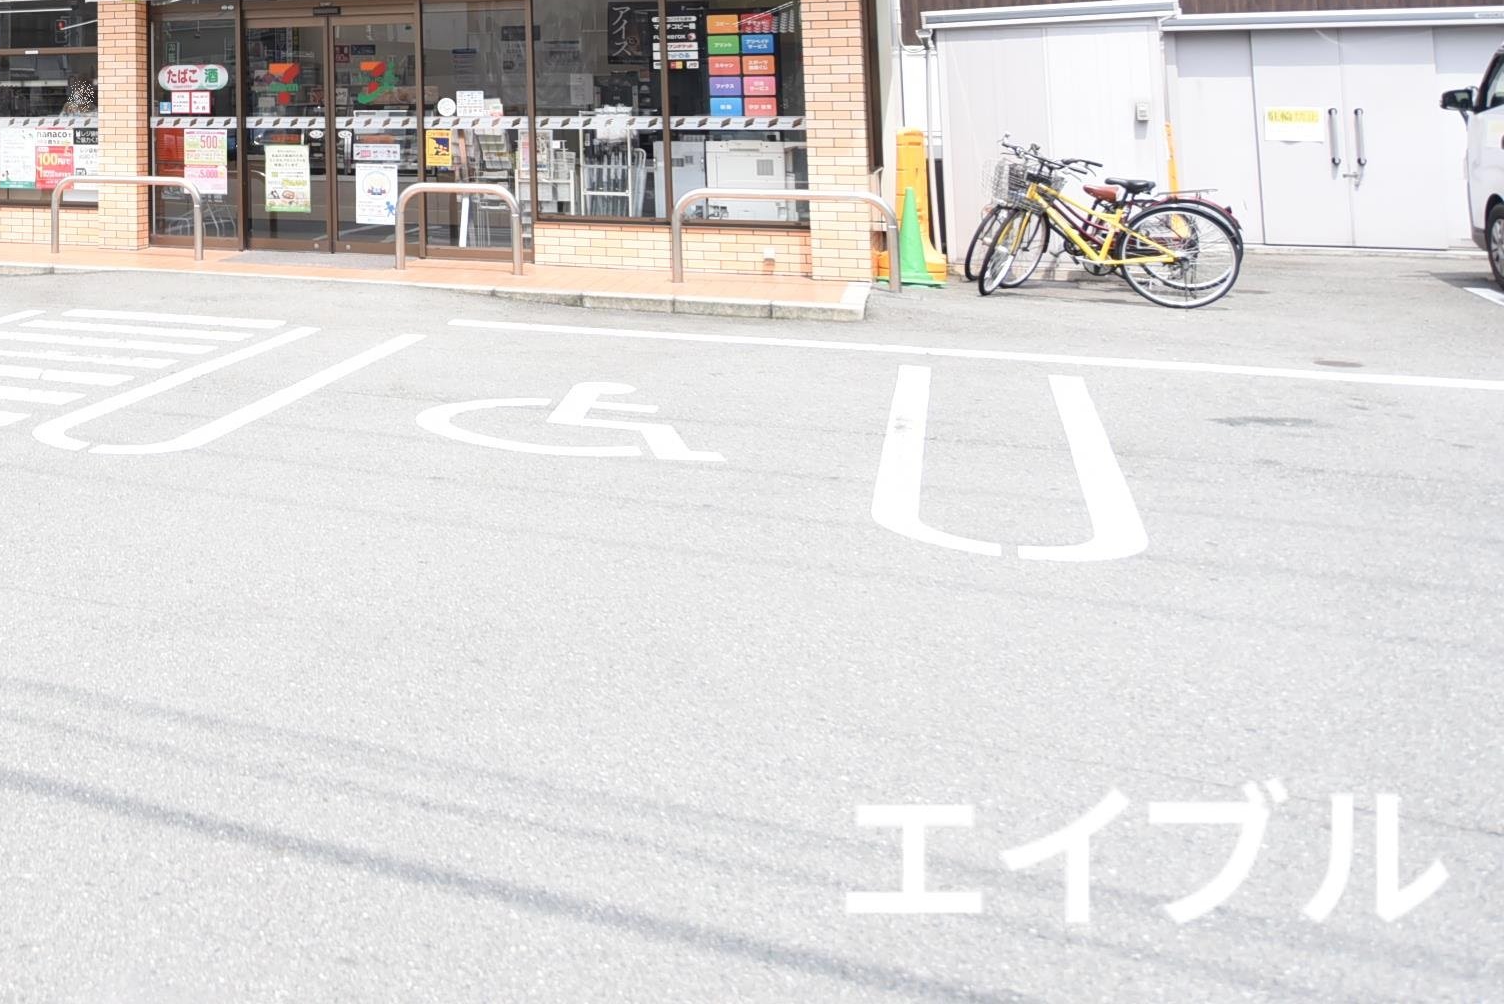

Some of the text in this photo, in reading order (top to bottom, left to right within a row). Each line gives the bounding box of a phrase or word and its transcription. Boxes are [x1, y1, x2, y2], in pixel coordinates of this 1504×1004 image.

[612, 6, 632, 57] アイス
[167, 68, 219, 84] たばこ 酒
